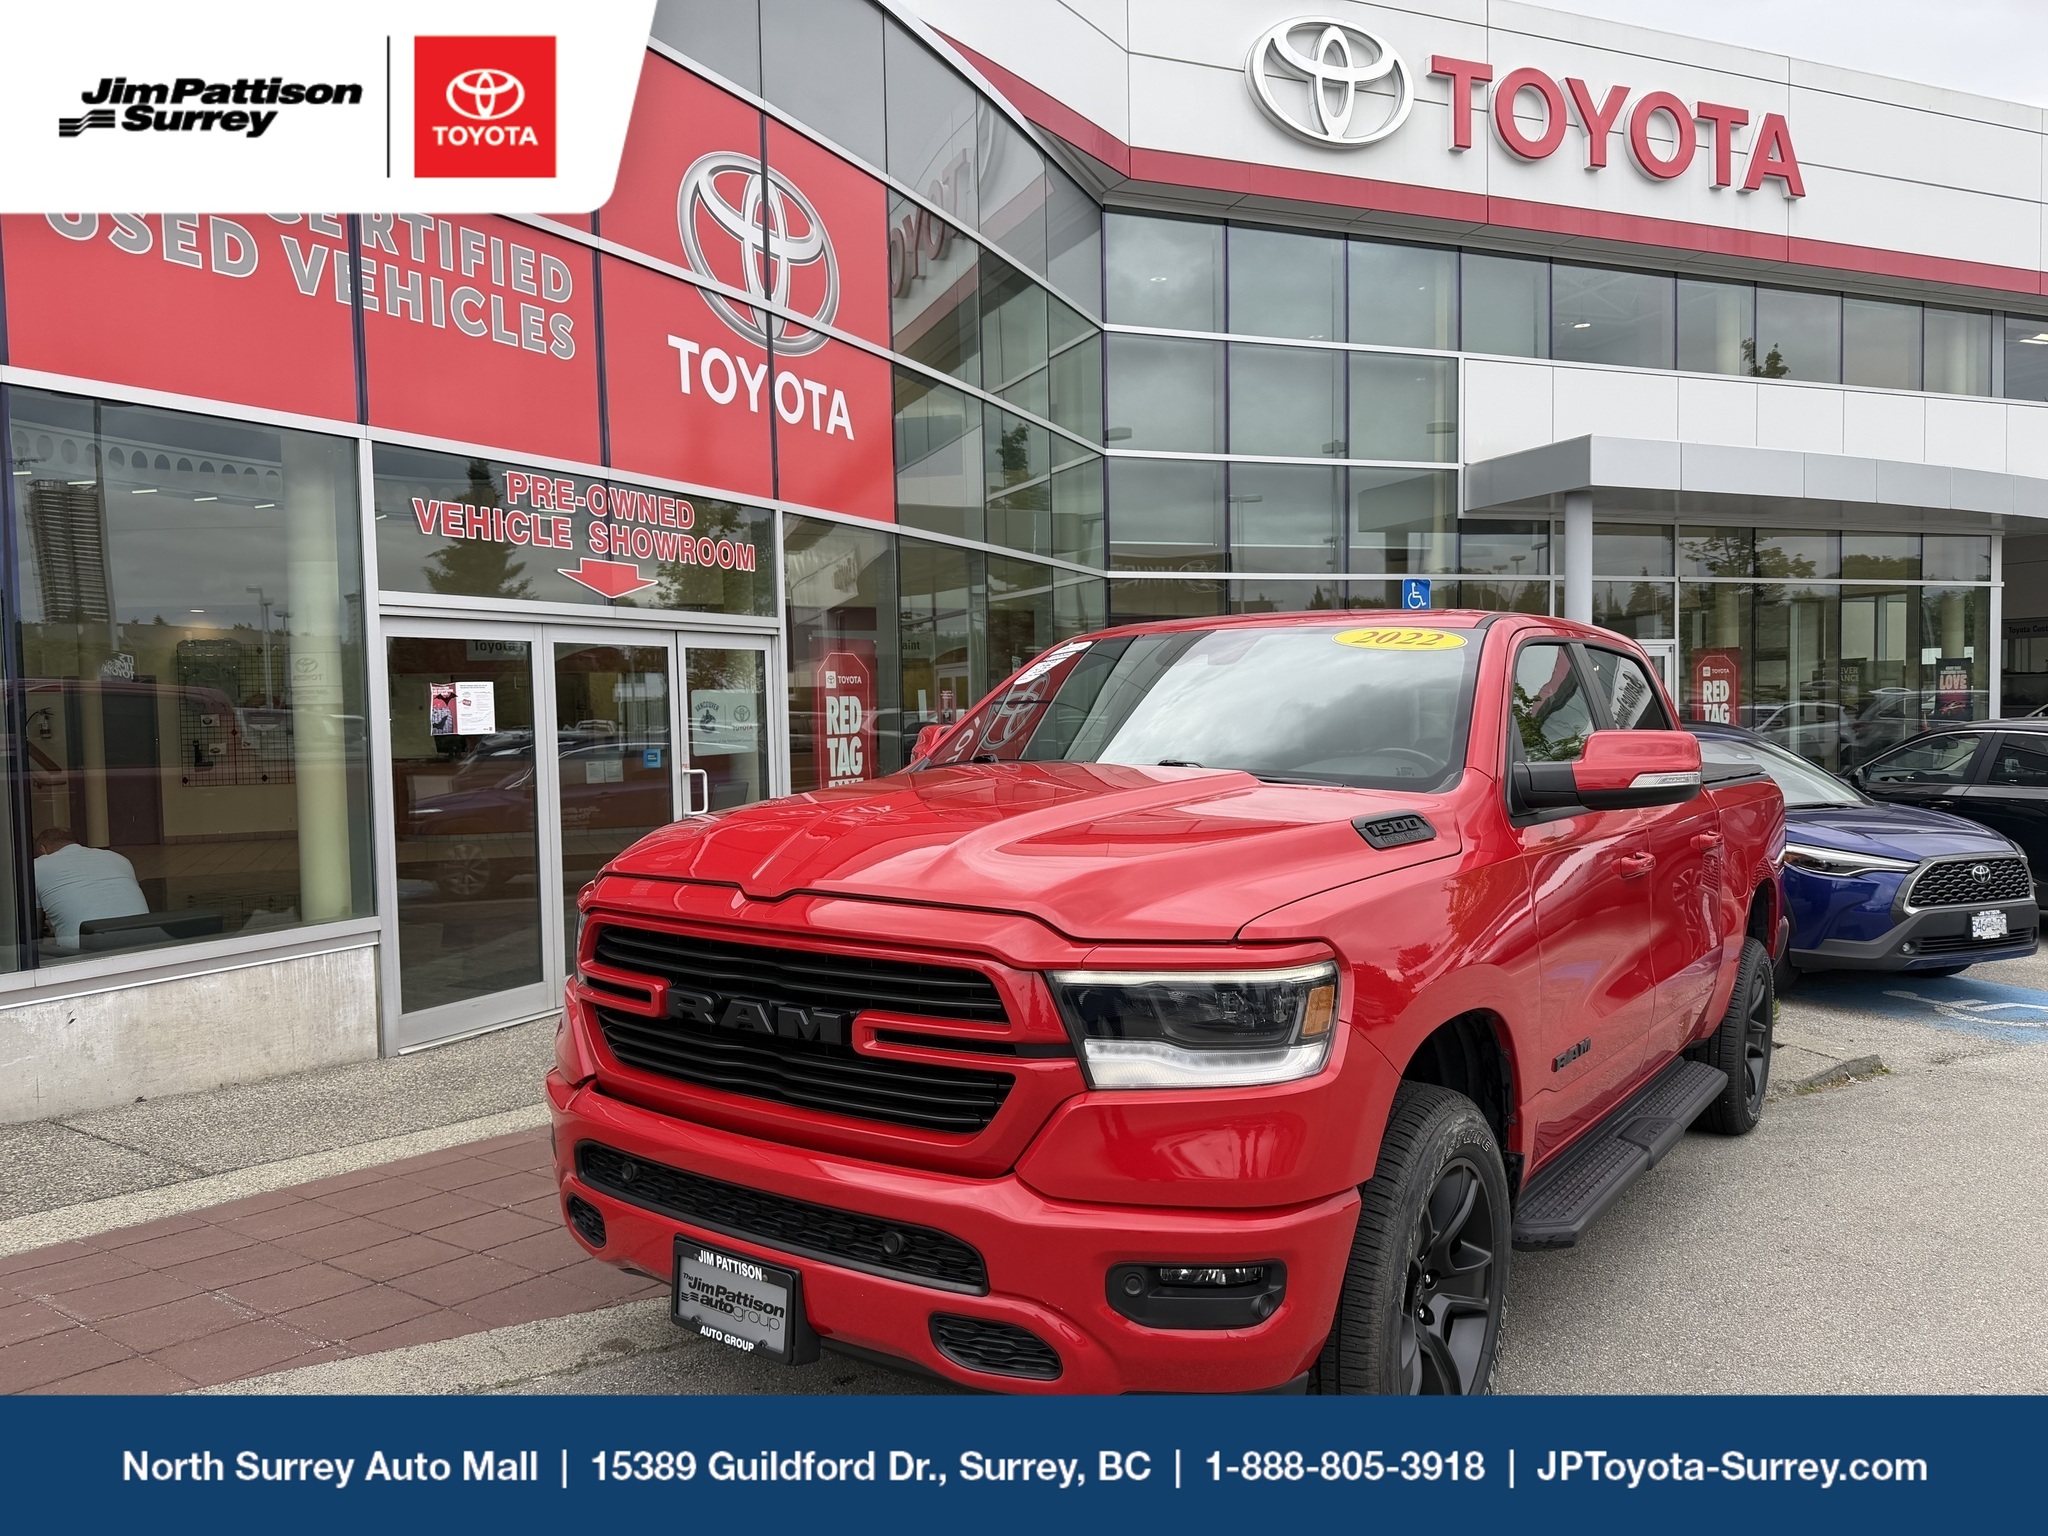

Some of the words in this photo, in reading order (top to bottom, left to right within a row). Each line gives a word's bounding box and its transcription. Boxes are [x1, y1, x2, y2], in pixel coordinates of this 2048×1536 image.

[1425, 54, 1806, 199] TOYOTA
[266, 213, 574, 304] RTIFIED
[280, 235, 576, 360] VEHICLES
[667, 333, 855, 441] TOYOTA
[506, 470, 695, 530] PRE-OWNED
[412, 498, 573, 550] VEHICLE
[588, 522, 756, 572] SHOWROOM
[900, 640, 921, 650] aint
[1351, 631, 1444, 646] 2022
[837, 675, 862, 685] TOYOTA
[1702, 680, 1730, 703] RED
[1939, 674, 1968, 690] LOVE
[826, 695, 862, 735] RED
[1702, 703, 1731, 724] TAG
[827, 736, 863, 777] TAG
[1368, 817, 1420, 836] 1500
[667, 985, 846, 1046] RAM
[1551, 1037, 1592, 1072] RAM
[683, 1272, 694, 1281] The
[698, 1250, 714, 1266] JIM
[716, 1255, 763, 1281] PATTISON
[700, 1325, 723, 1341] AUTO
[724, 1333, 755, 1352] GROUP
